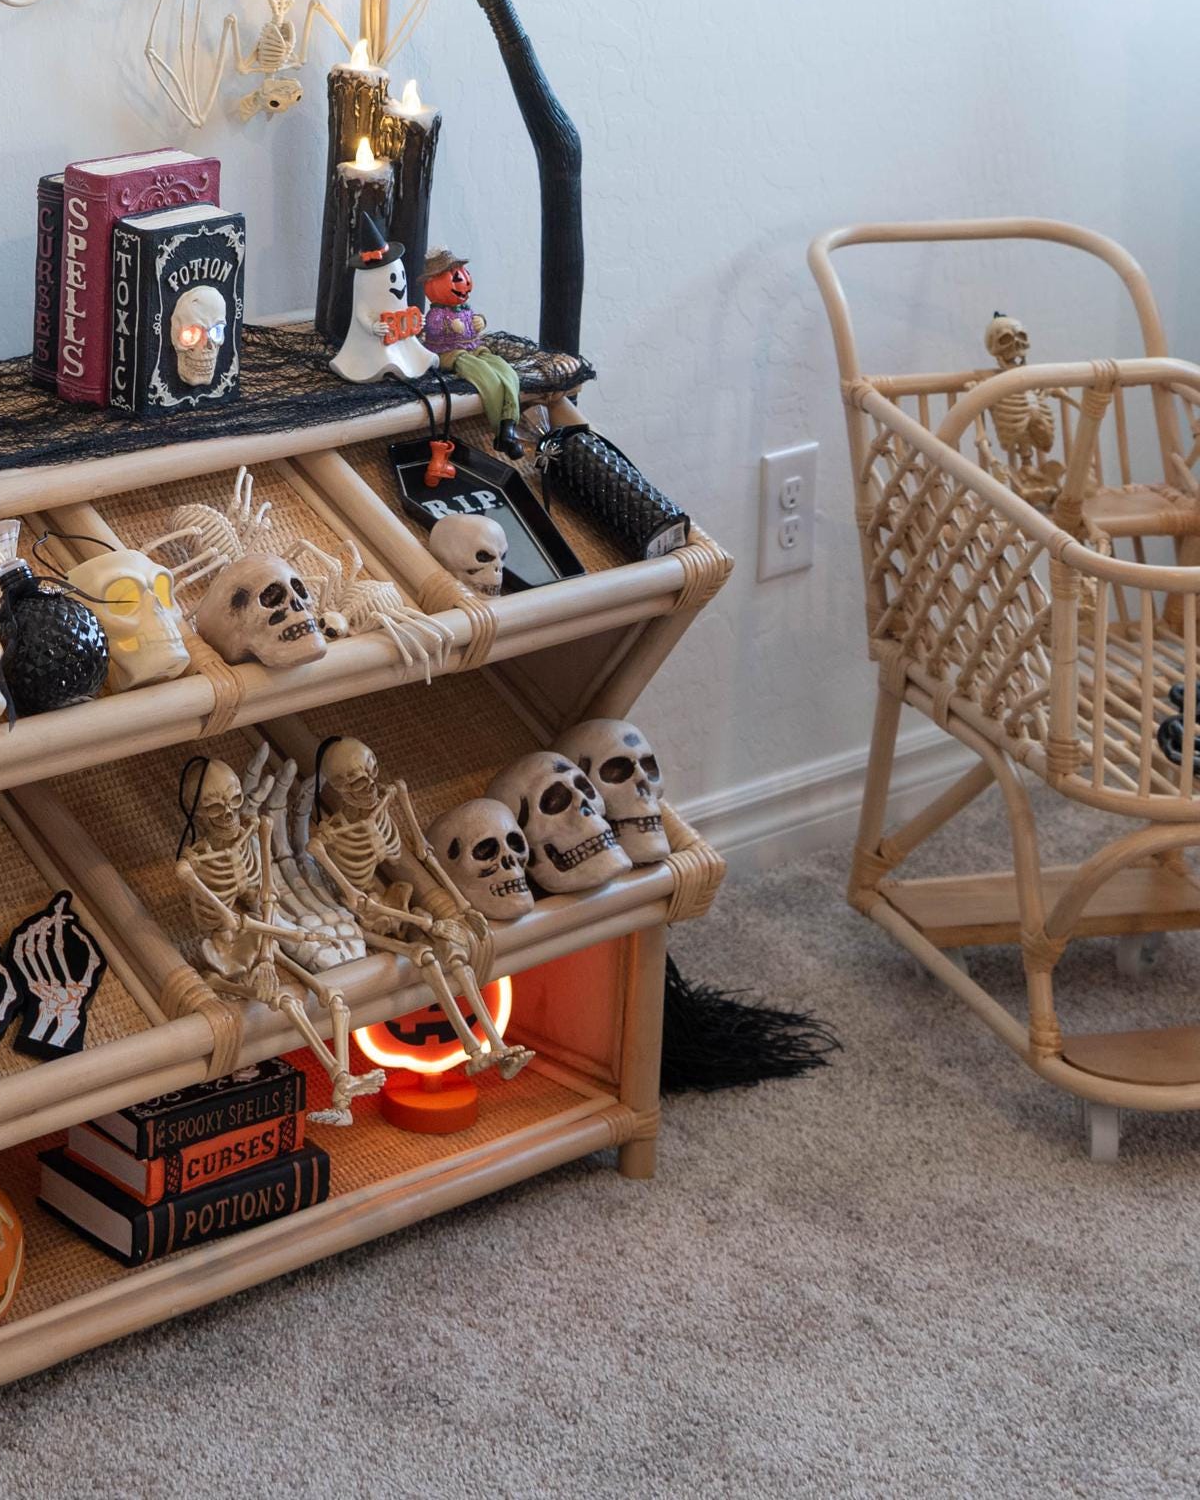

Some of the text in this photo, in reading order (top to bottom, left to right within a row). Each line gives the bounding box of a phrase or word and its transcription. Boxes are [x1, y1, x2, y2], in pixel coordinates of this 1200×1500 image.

[36, 206, 55, 363] CURSES
[62, 196, 89, 378] SPELLS
[167, 257, 234, 293] POTION
[114, 251, 132, 391] TOXIC
[380, 306, 423, 346] BOO
[421, 490, 503, 520] R.I.P.
[167, 1091, 281, 1145] SPOOKY SPELLS
[186, 1128, 276, 1181] CURSES
[181, 1182, 287, 1242] POTIONS
